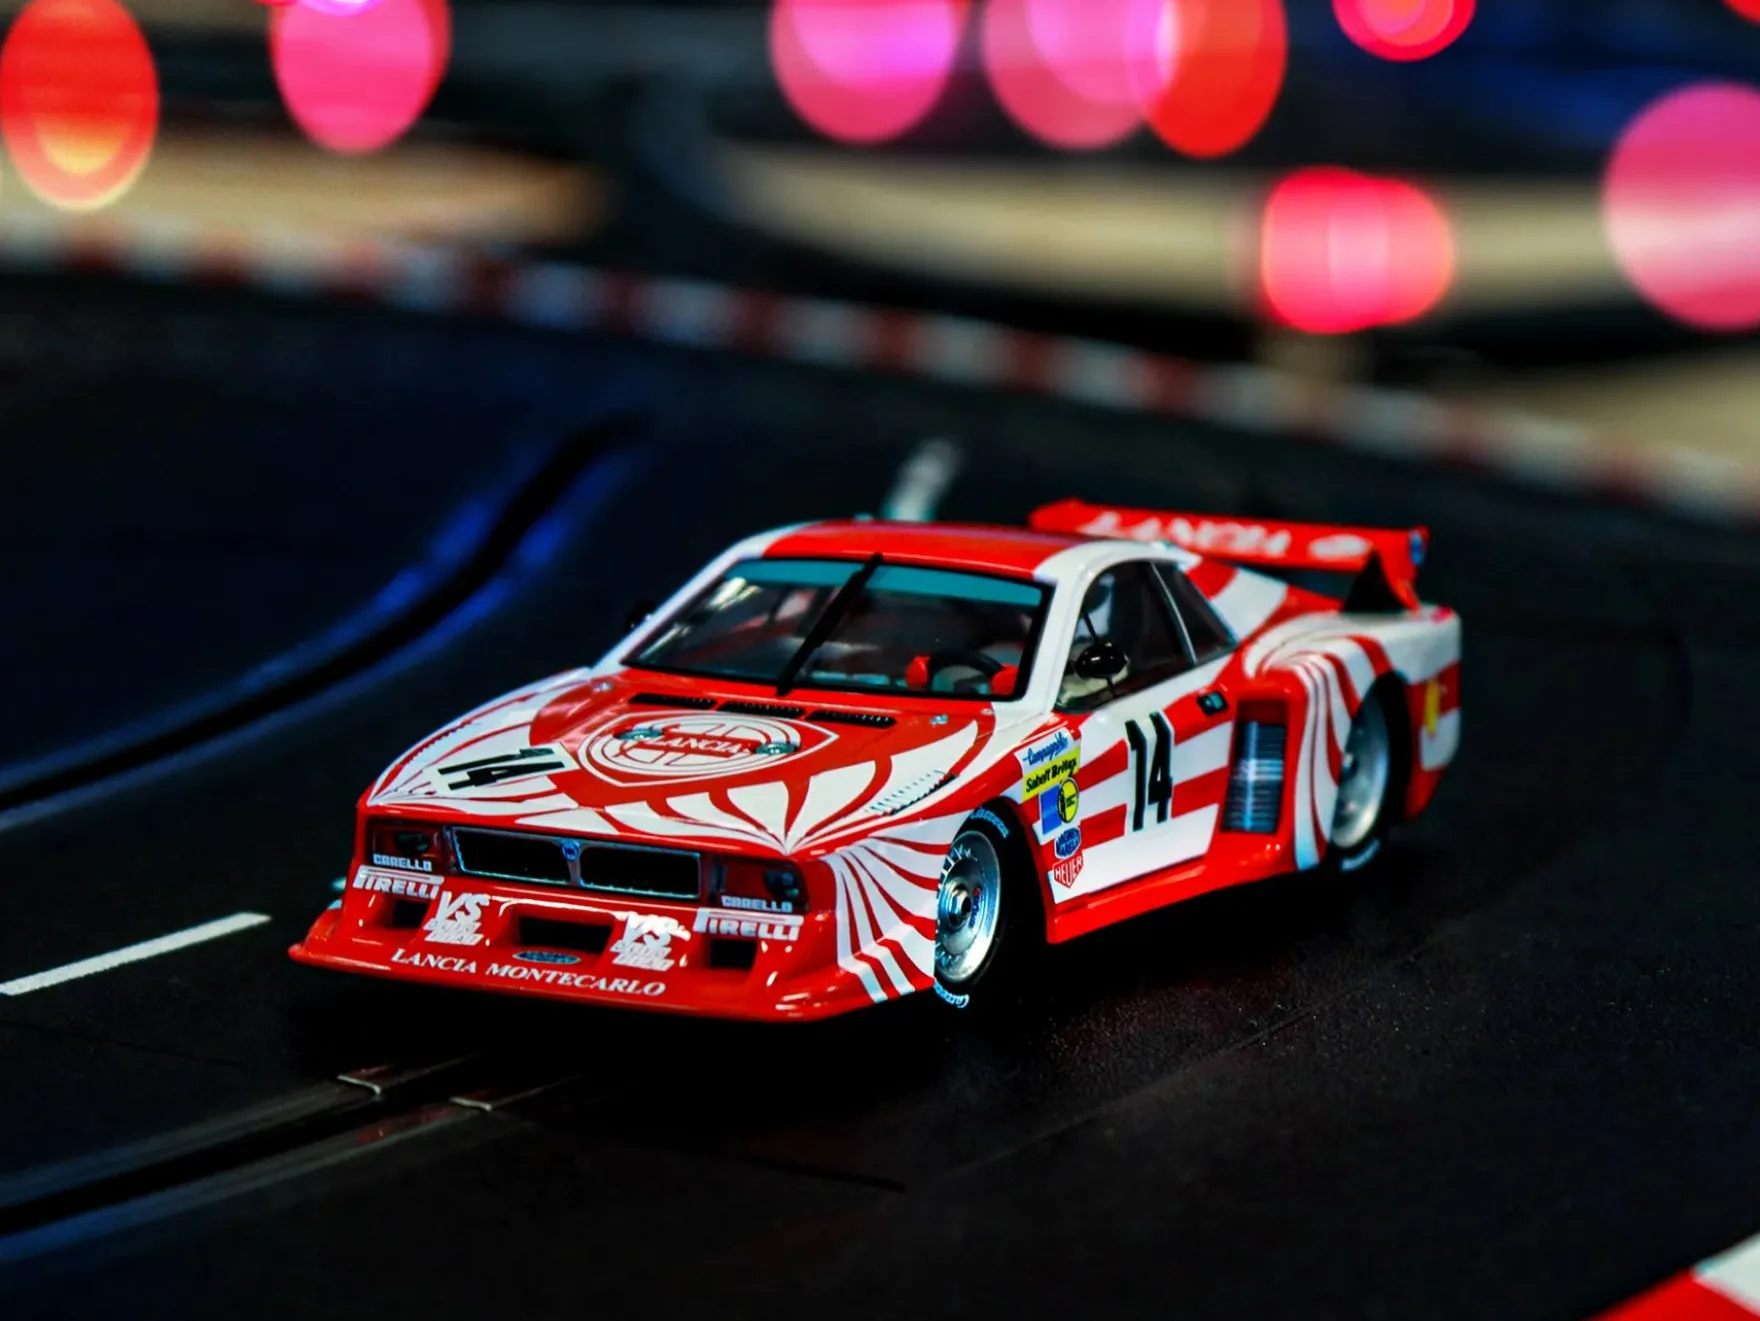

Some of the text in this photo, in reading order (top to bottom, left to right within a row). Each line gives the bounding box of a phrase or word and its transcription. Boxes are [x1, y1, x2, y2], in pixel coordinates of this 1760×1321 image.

[1077, 511, 1292, 558] LANCIA
[651, 735, 743, 754] LANCIA
[437, 748, 565, 791] 14
[1125, 711, 1173, 832] 14
[373, 853, 432, 872] CARELLO
[1055, 856, 1083, 887] HEUER
[353, 865, 444, 899] PIRELLI
[434, 891, 491, 925] VS
[721, 895, 793, 913] CARELLO
[693, 907, 804, 941] PIRELLI
[391, 948, 477, 974] LANCIA
[485, 963, 666, 996] MONTECARLO
